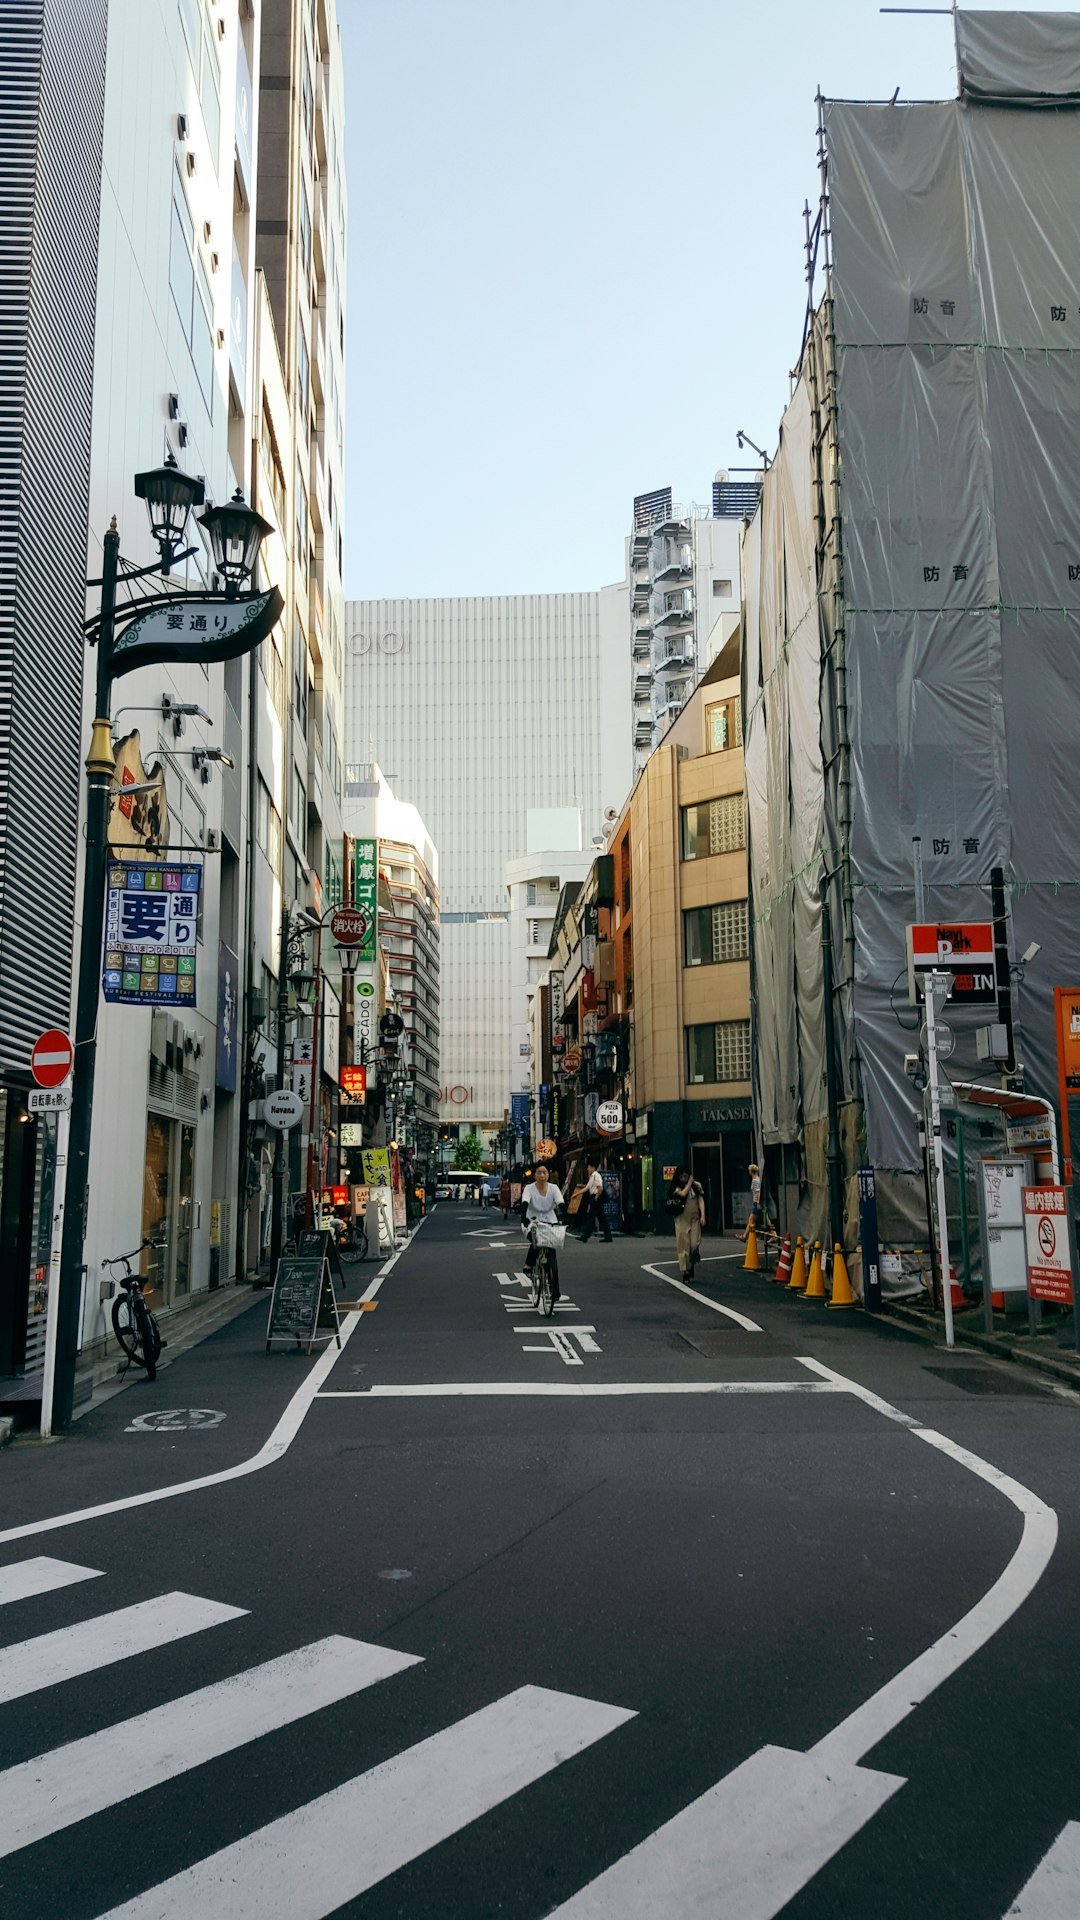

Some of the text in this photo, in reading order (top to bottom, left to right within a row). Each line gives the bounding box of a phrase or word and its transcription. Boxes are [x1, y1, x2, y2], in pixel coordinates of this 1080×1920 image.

[913, 298, 956, 316] 防音
[1051, 306, 1080, 322] 防
[923, 564, 969, 582] 防音
[166, 613, 229, 632] 要通り
[932, 837, 980, 855] 防音
[109, 890, 118, 941] 新宿三丁目
[121, 893, 194, 943] 要 通り
[333, 919, 365, 934] 消火栓
[936, 927, 963, 941] Navi
[973, 974, 994, 990] IN
[31, 1093, 68, 1107] 自転車を除く
[271, 1106, 295, 1114] Havana
[601, 1115, 618, 1124] 500
[1025, 1192, 1065, 1211] 場内禁煙
[1036, 1255, 1062, 1269] No smoking
